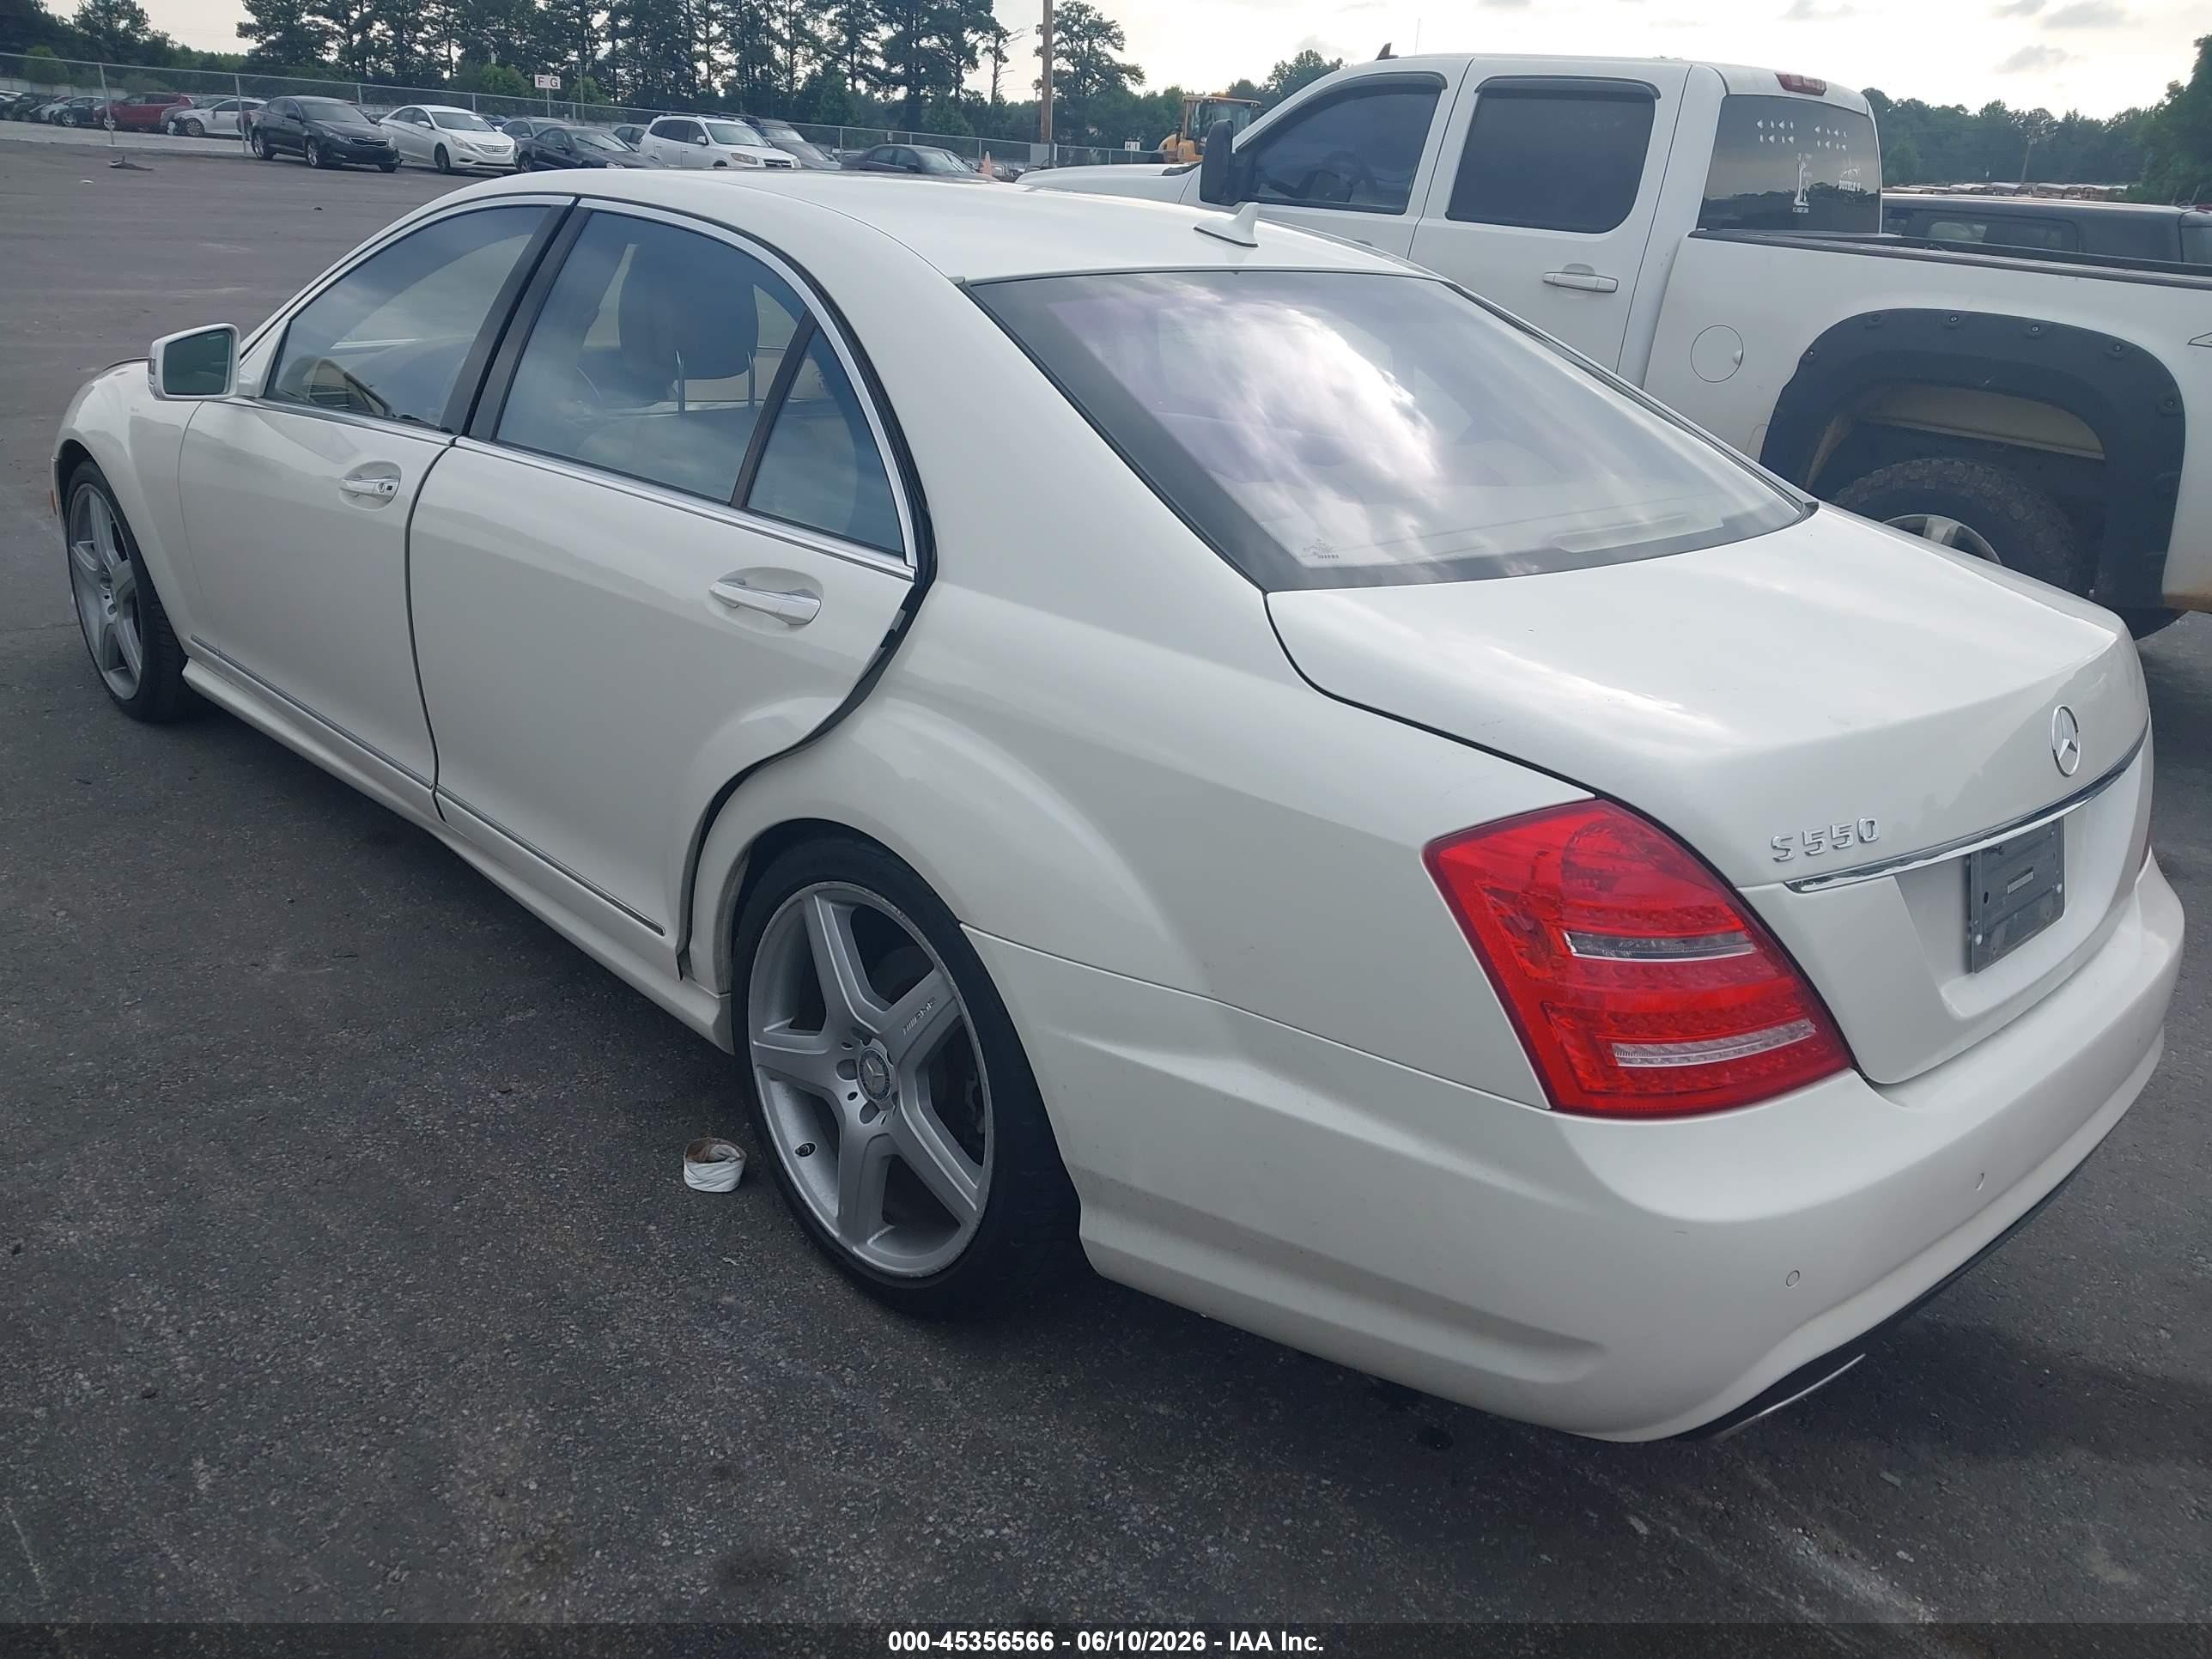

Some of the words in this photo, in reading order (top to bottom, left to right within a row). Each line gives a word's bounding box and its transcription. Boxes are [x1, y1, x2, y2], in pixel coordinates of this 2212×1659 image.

[538, 76, 544, 86] F
[550, 77, 558, 88] G
[1771, 836, 1795, 862] S
[1802, 817, 1879, 856] 550
